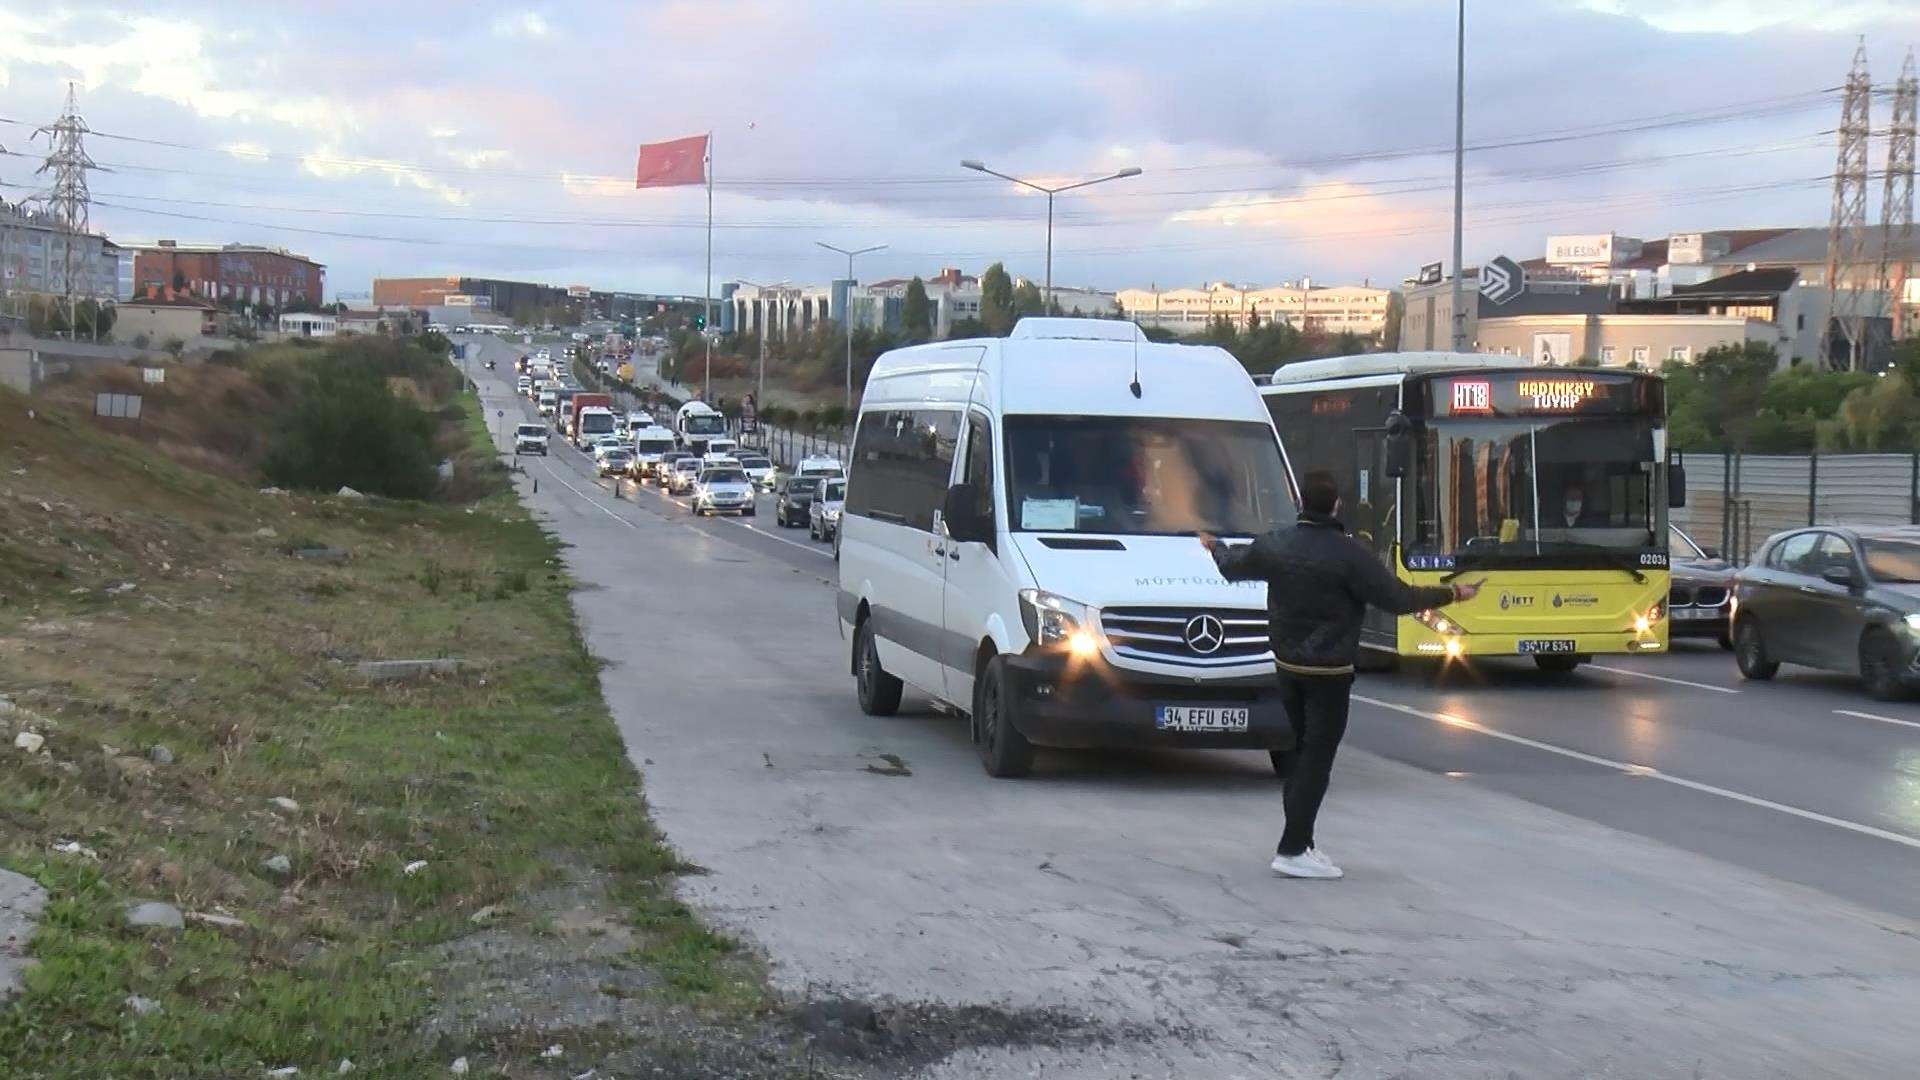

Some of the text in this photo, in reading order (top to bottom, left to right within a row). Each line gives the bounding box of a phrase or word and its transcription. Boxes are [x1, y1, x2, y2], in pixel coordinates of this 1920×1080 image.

[1454, 383, 1488, 408] HT18
[1640, 553, 1667, 565] 02036
[1540, 640, 1551, 651] TP
[1552, 640, 1574, 652] 6341
[1166, 708, 1246, 726] 34 EFU 649
